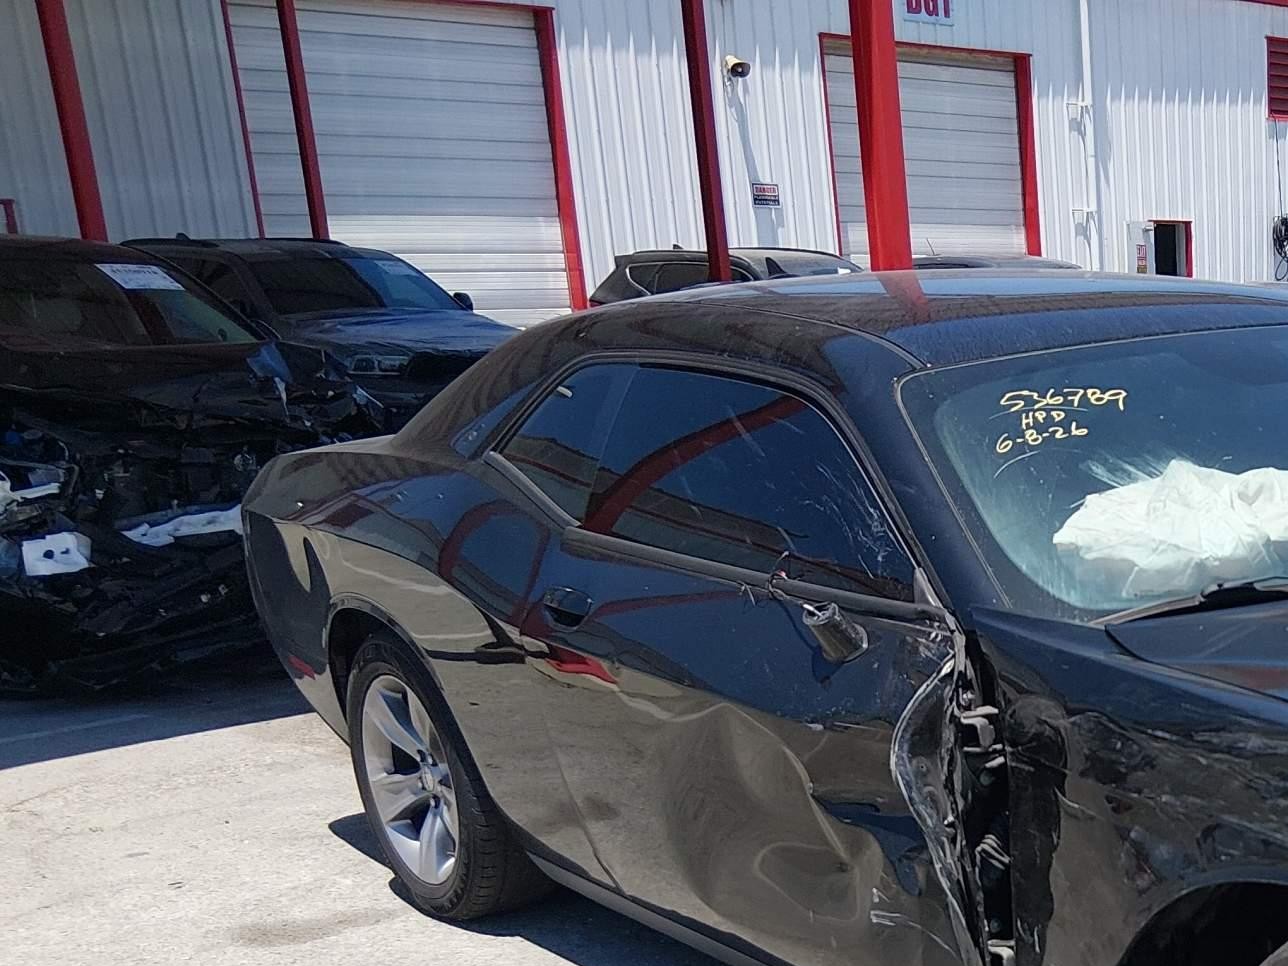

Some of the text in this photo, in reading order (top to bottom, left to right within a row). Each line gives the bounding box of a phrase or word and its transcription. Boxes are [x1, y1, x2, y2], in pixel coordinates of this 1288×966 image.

[1000, 388, 1127, 411] 536789
[1022, 411, 1065, 429] HPD
[995, 421, 1089, 453] 6-8-26
